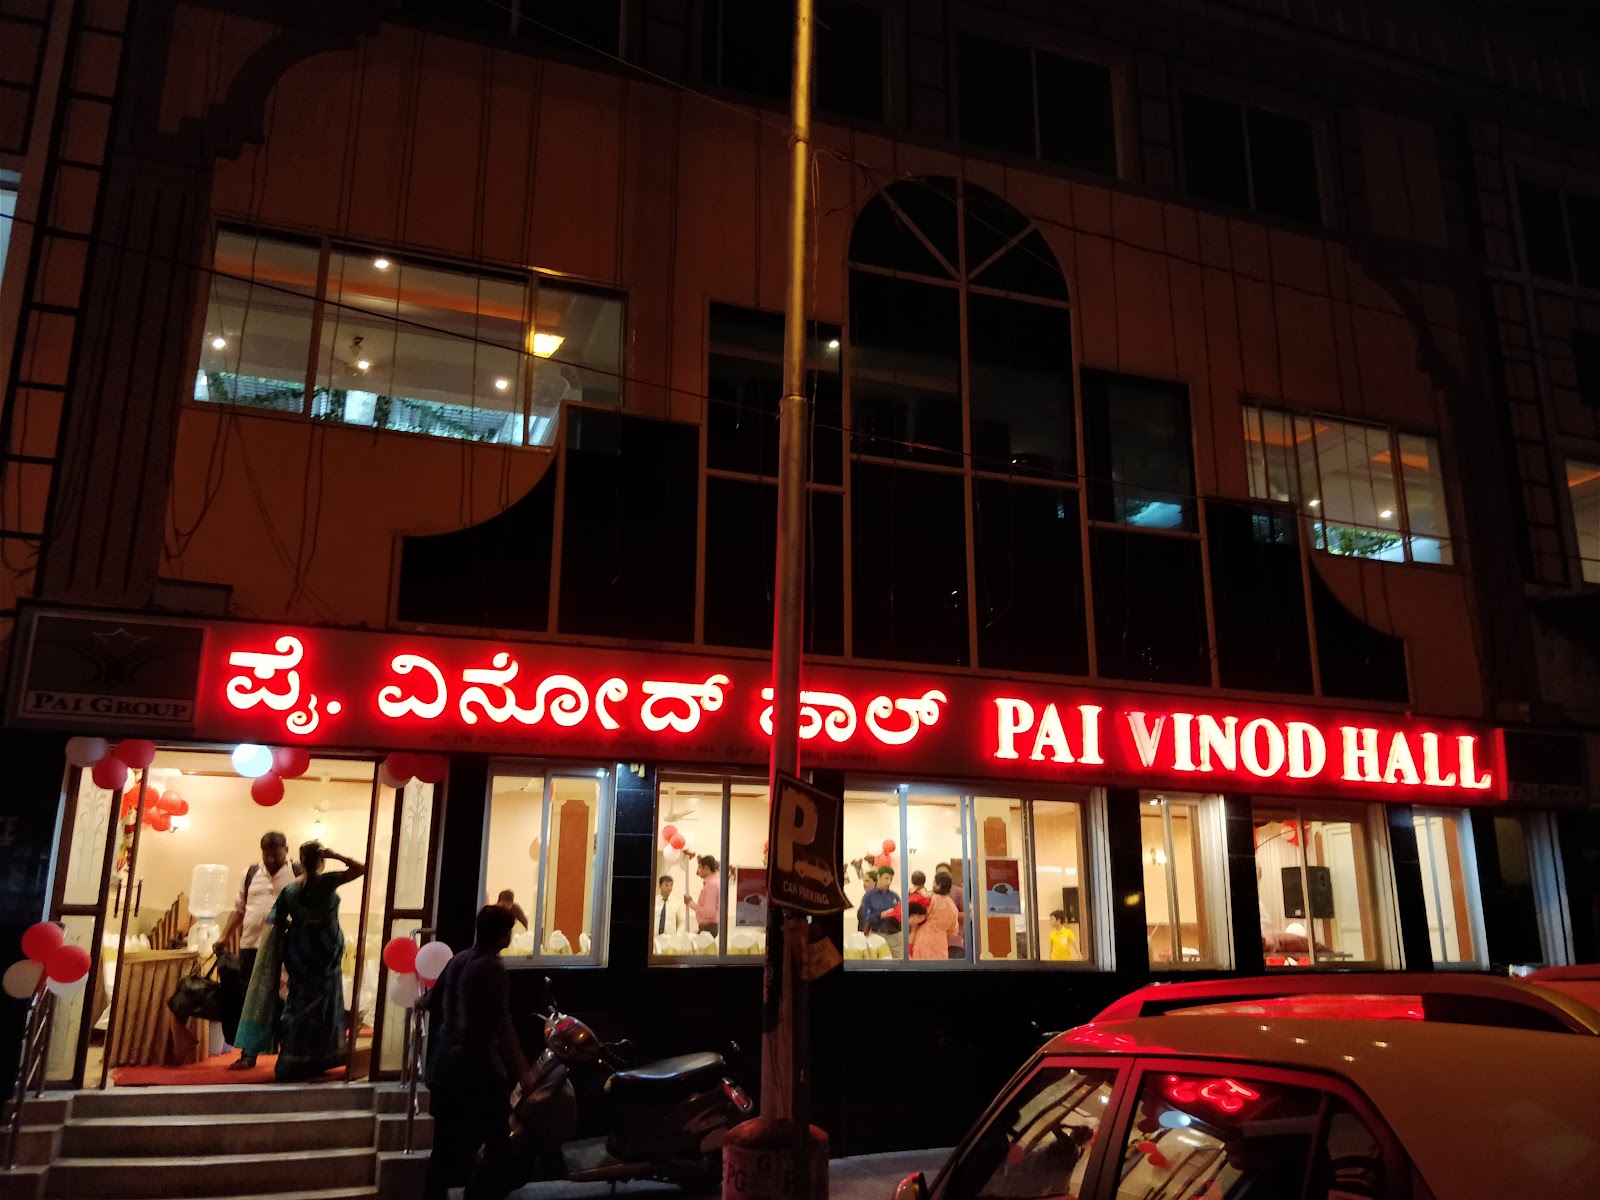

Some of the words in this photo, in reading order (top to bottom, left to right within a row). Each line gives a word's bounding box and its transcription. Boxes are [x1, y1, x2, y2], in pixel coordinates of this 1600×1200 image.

[33, 692, 82, 712] PAI
[89, 696, 187, 717] GROUP
[378, 653, 730, 733] ವಿನೋದ್
[994, 697, 1104, 765] PAI
[1124, 710, 1327, 779] VINOD
[1341, 726, 1492, 790] HALL
[777, 786, 818, 874] P
[782, 879, 798, 897] CAR
[799, 885, 830, 906] PARKING
